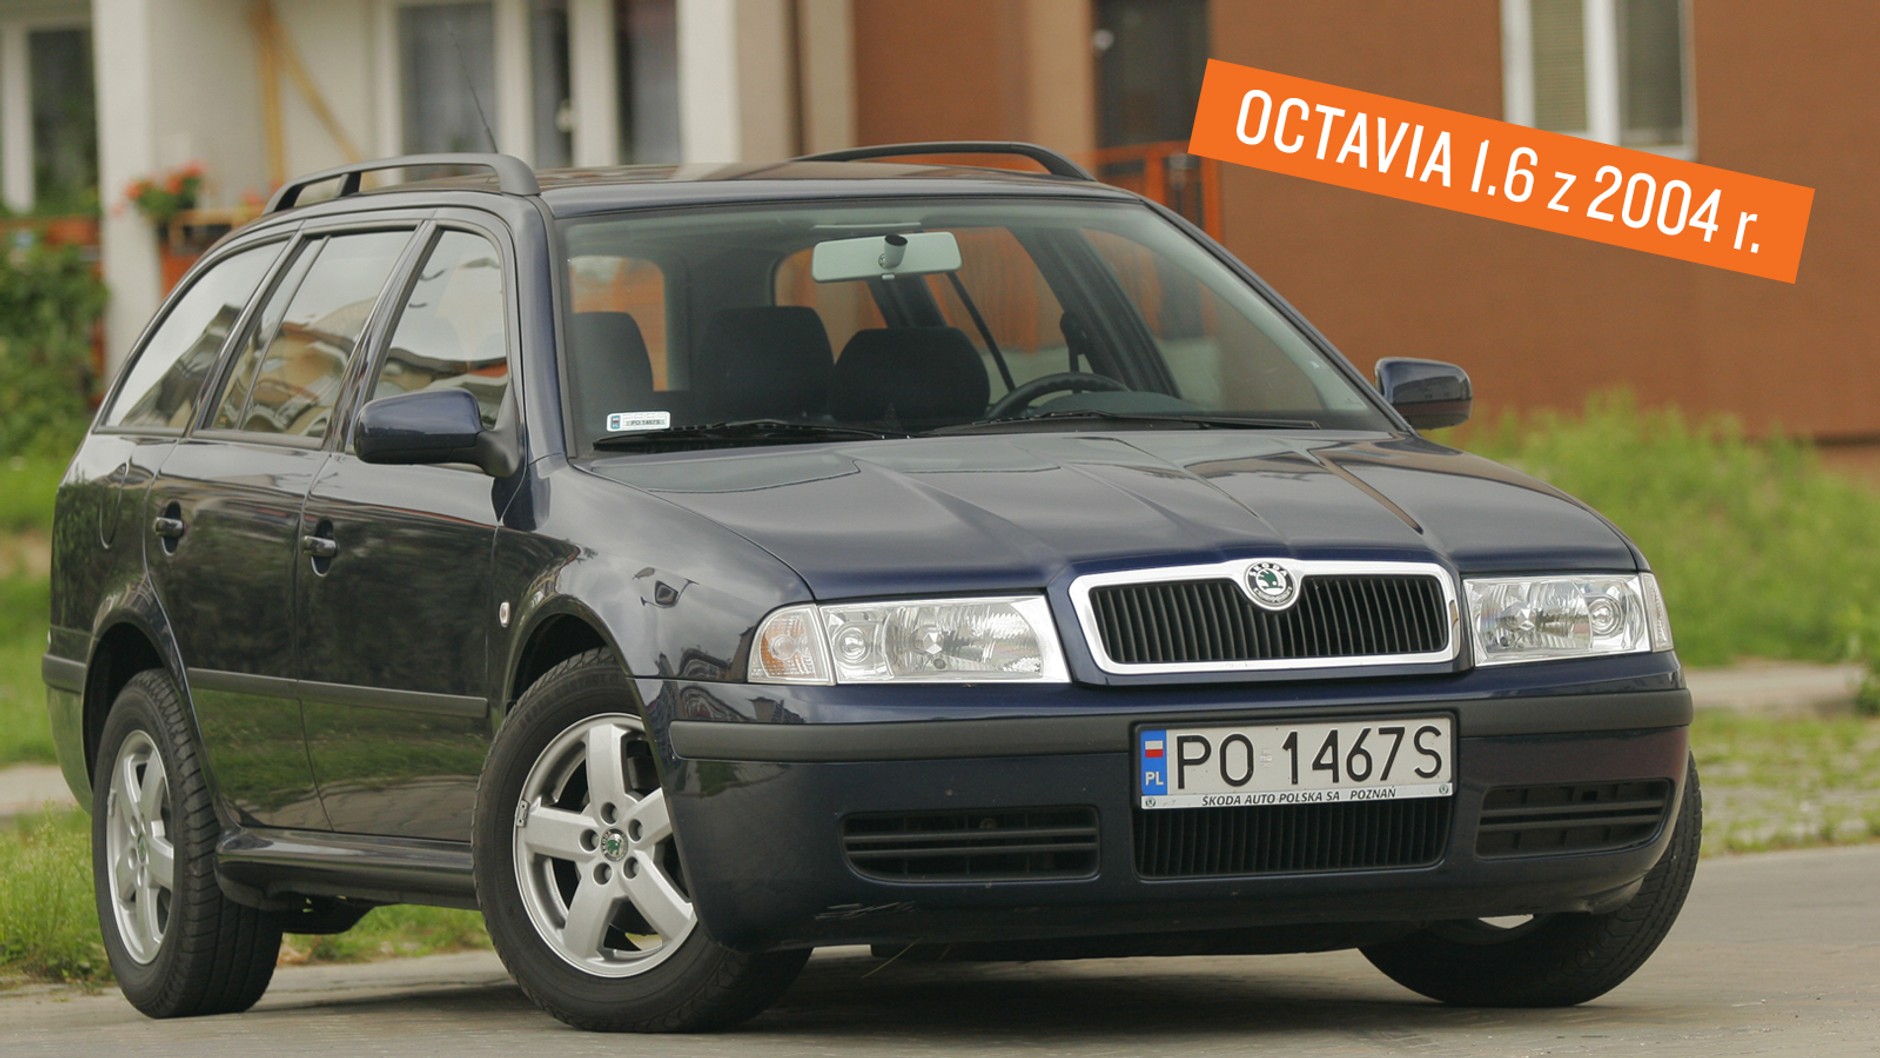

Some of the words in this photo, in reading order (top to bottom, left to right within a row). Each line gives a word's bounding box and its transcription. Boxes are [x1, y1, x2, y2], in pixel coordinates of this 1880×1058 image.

[1176, 734, 1255, 790] PO
[1281, 725, 1442, 785] 1467S
[1144, 771, 1164, 787] PL
[1244, 793, 1276, 805] AUTO
[1278, 791, 1323, 804] POLSKA
[1326, 791, 1340, 802] SA
[1350, 785, 1397, 800] POZNAŃ
